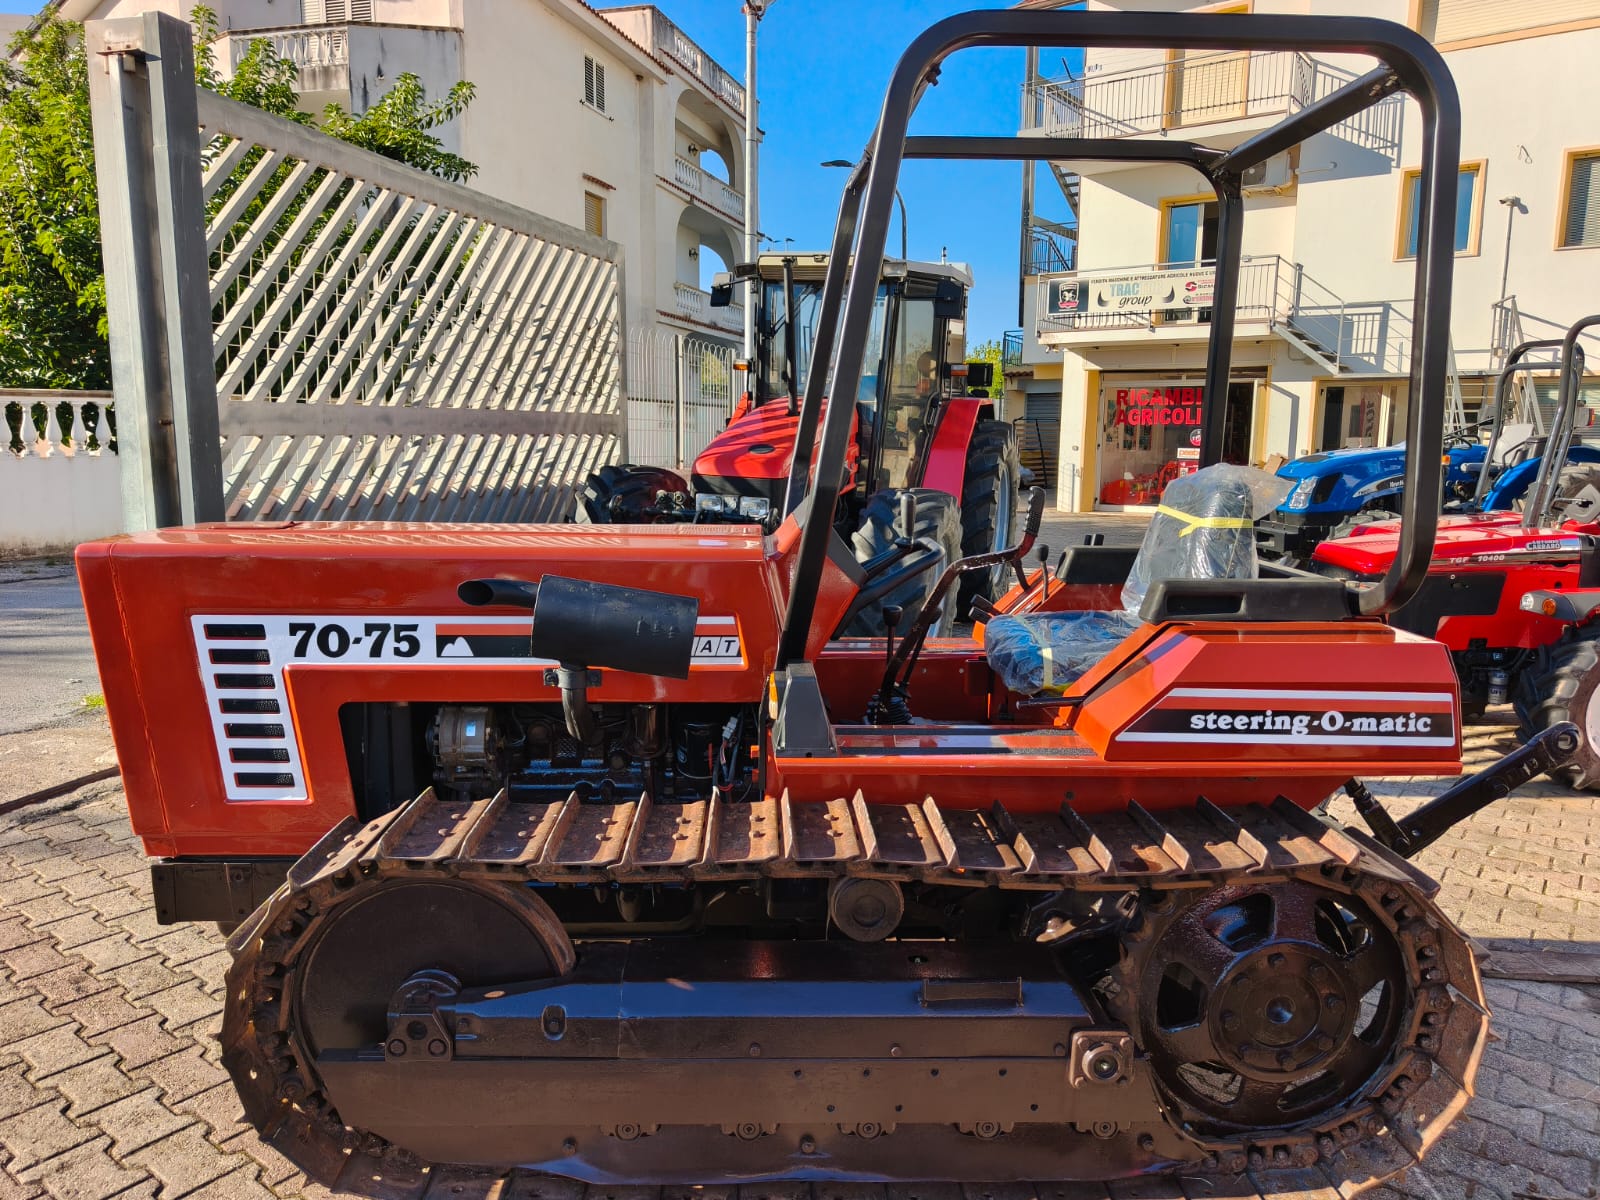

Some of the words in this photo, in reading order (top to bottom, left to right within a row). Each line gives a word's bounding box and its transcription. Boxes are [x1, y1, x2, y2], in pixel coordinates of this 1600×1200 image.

[1118, 296, 1152, 308] group
[1116, 387, 1203, 406] RICAMBI
[1114, 408, 1202, 427] AGRICOLI
[1478, 554, 1505, 562] 10400
[288, 622, 421, 658] 70-75
[700, 640, 736, 653] AT
